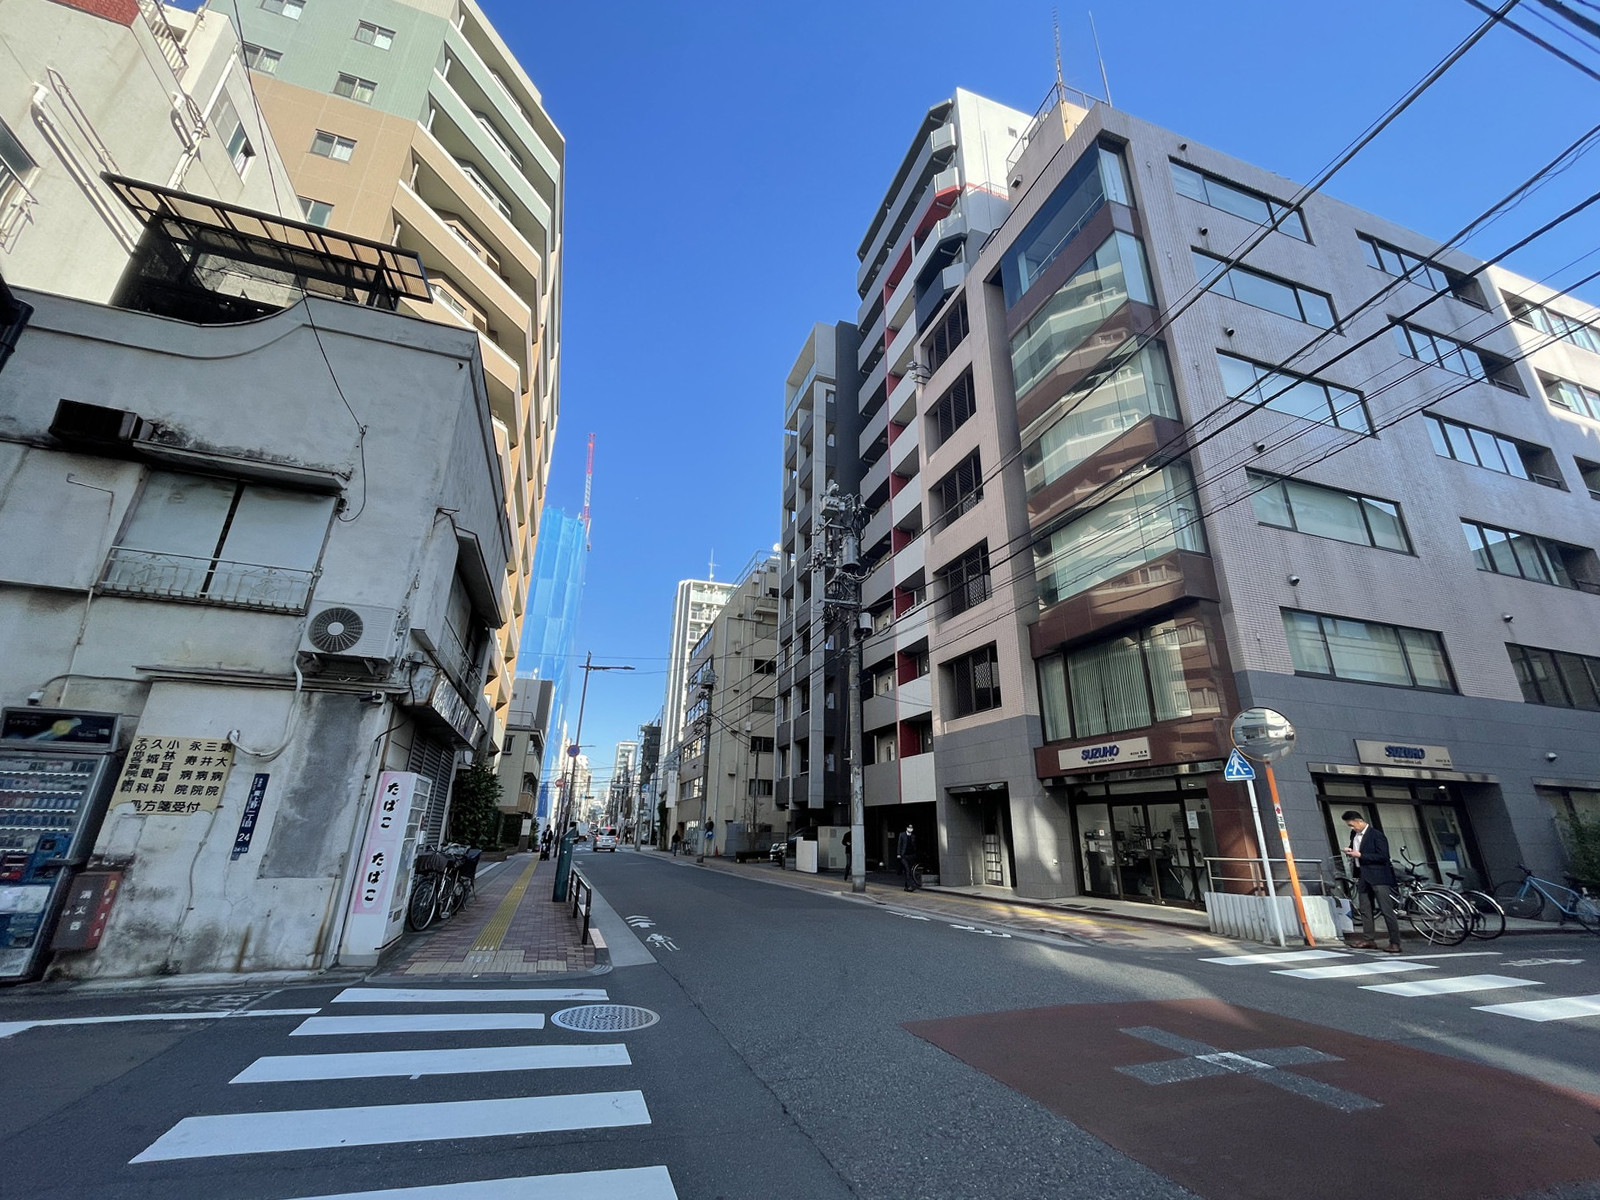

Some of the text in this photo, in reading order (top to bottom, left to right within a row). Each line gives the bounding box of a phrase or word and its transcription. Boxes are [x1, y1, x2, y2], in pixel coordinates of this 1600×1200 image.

[151, 740, 180, 794] 小林耳鼻科
[174, 741, 202, 795] 永寿病院
[190, 742, 217, 796] 三井病院
[205, 742, 232, 797] 東大病院
[1081, 745, 1120, 761] SUZUHO
[380, 782, 400, 829] たばこ
[237, 833, 250, 841] 24
[364, 852, 385, 902] たばこ
